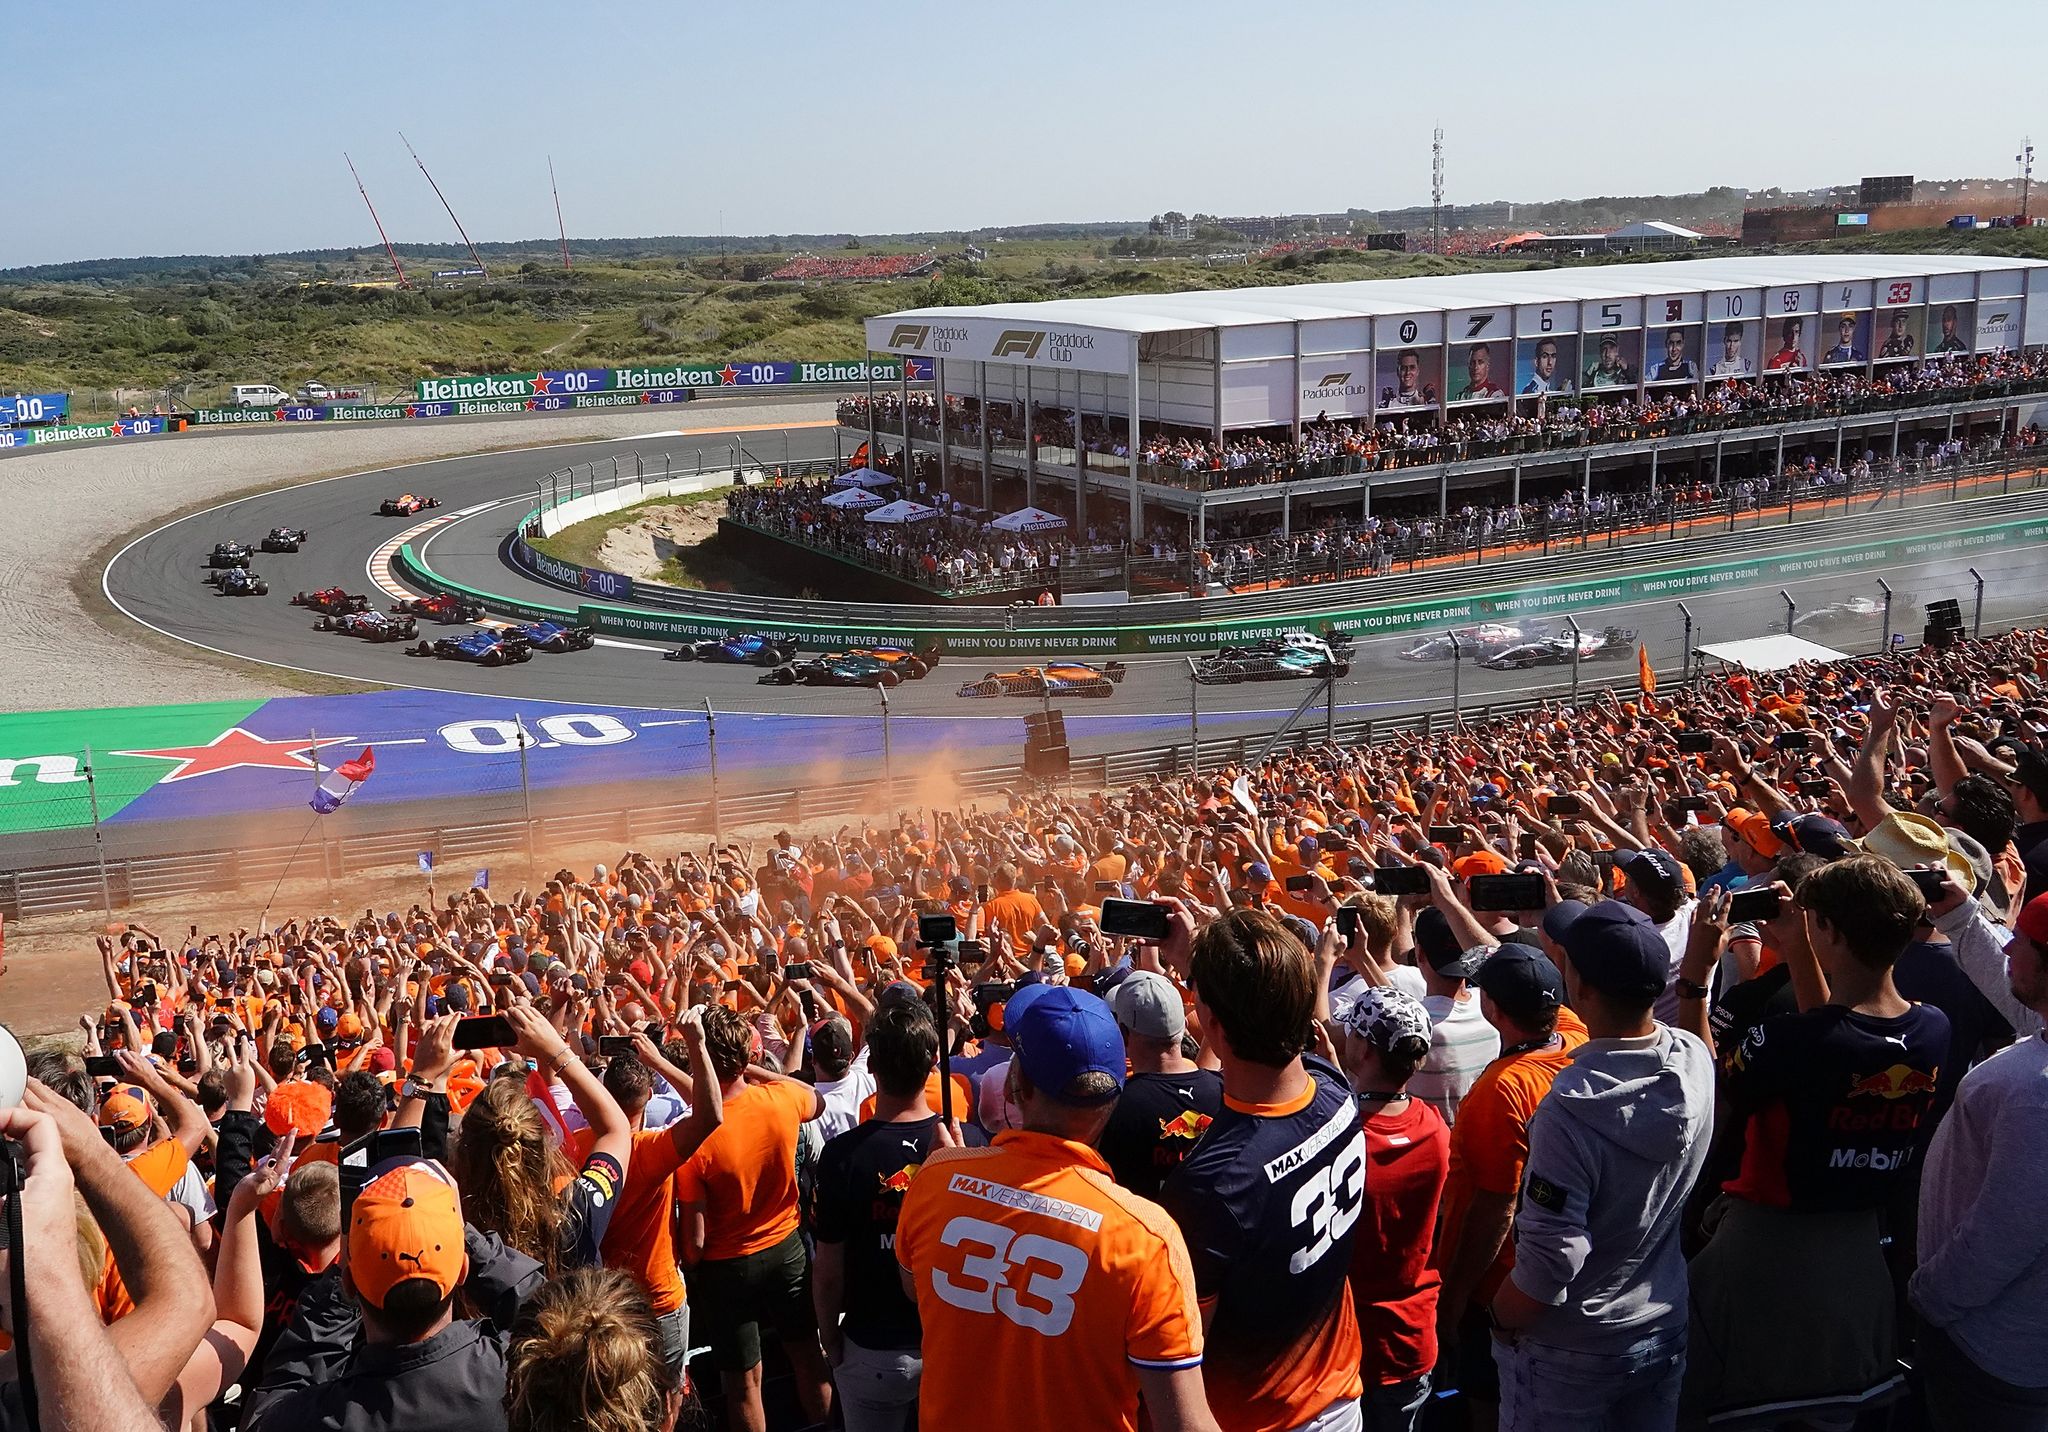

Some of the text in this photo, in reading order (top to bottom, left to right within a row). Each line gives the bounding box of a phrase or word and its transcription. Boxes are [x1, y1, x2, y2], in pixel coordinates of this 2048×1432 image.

[1784, 291, 1799, 312] 55
[1841, 287, 1853, 307] 4
[1887, 282, 1912, 304] 33
[1601, 304, 1622, 327] 5
[1726, 295, 1743, 317] 10
[1402, 323, 1415, 340] 47
[1465, 313, 1495, 339] 7
[1541, 309, 1553, 332] 6
[933, 325, 968, 341] Paddock
[1050, 331, 1094, 349] Paddock
[933, 339, 951, 353] Club
[1050, 346, 1072, 362] Club
[616, 364, 774, 389] Heineken 0.0
[801, 362, 895, 382] Heineken
[421, 372, 589, 400] Heineken 0.0
[1303, 384, 1366, 399] Paddock Club
[16, 398, 43, 421] 0.0
[198, 391, 673, 423] Heineken 0.0 Heineken 0.0 Heineken 0.0 Heineken 0.0
[33, 425, 106, 444] Heineken
[134, 420, 151, 435] 0.0
[1023, 520, 1068, 532] Heineken
[1779, 550, 1886, 572] WHEN YOU DRIVE NEVER DRINK
[536, 552, 578, 585] Heineken
[599, 575, 615, 594] 0.0
[1643, 568, 1759, 592] WHEN YOU DRIVE NEVER DRINK
[1495, 587, 1621, 611] WHEN YOU DRIVE NEVER DRINK
[600, 615, 729, 637] WHEN YOU DRIVE NEVER DRINK
[1333, 606, 1471, 631] WHEN YOU DRIVE NEVER DRINK
[756, 630, 786, 642] WHEN
[813, 634, 842, 645] DRIVE
[845, 635, 878, 646] NEVER
[881, 637, 914, 647] DRINK
[947, 637, 1117, 648] WHEN YOU DRIVE NEVER DRINK
[1148, 634, 1181, 645] WHEN
[1183, 632, 1207, 643] YOU
[1209, 630, 1239, 641] DRIVE
[1242, 628, 1272, 639] NEVER
[437, 713, 638, 753] 0.0
[1829, 1147, 1904, 1170] Mobil
[1289, 1130, 1367, 1275] 33
[930, 1216, 1089, 1337] 33
